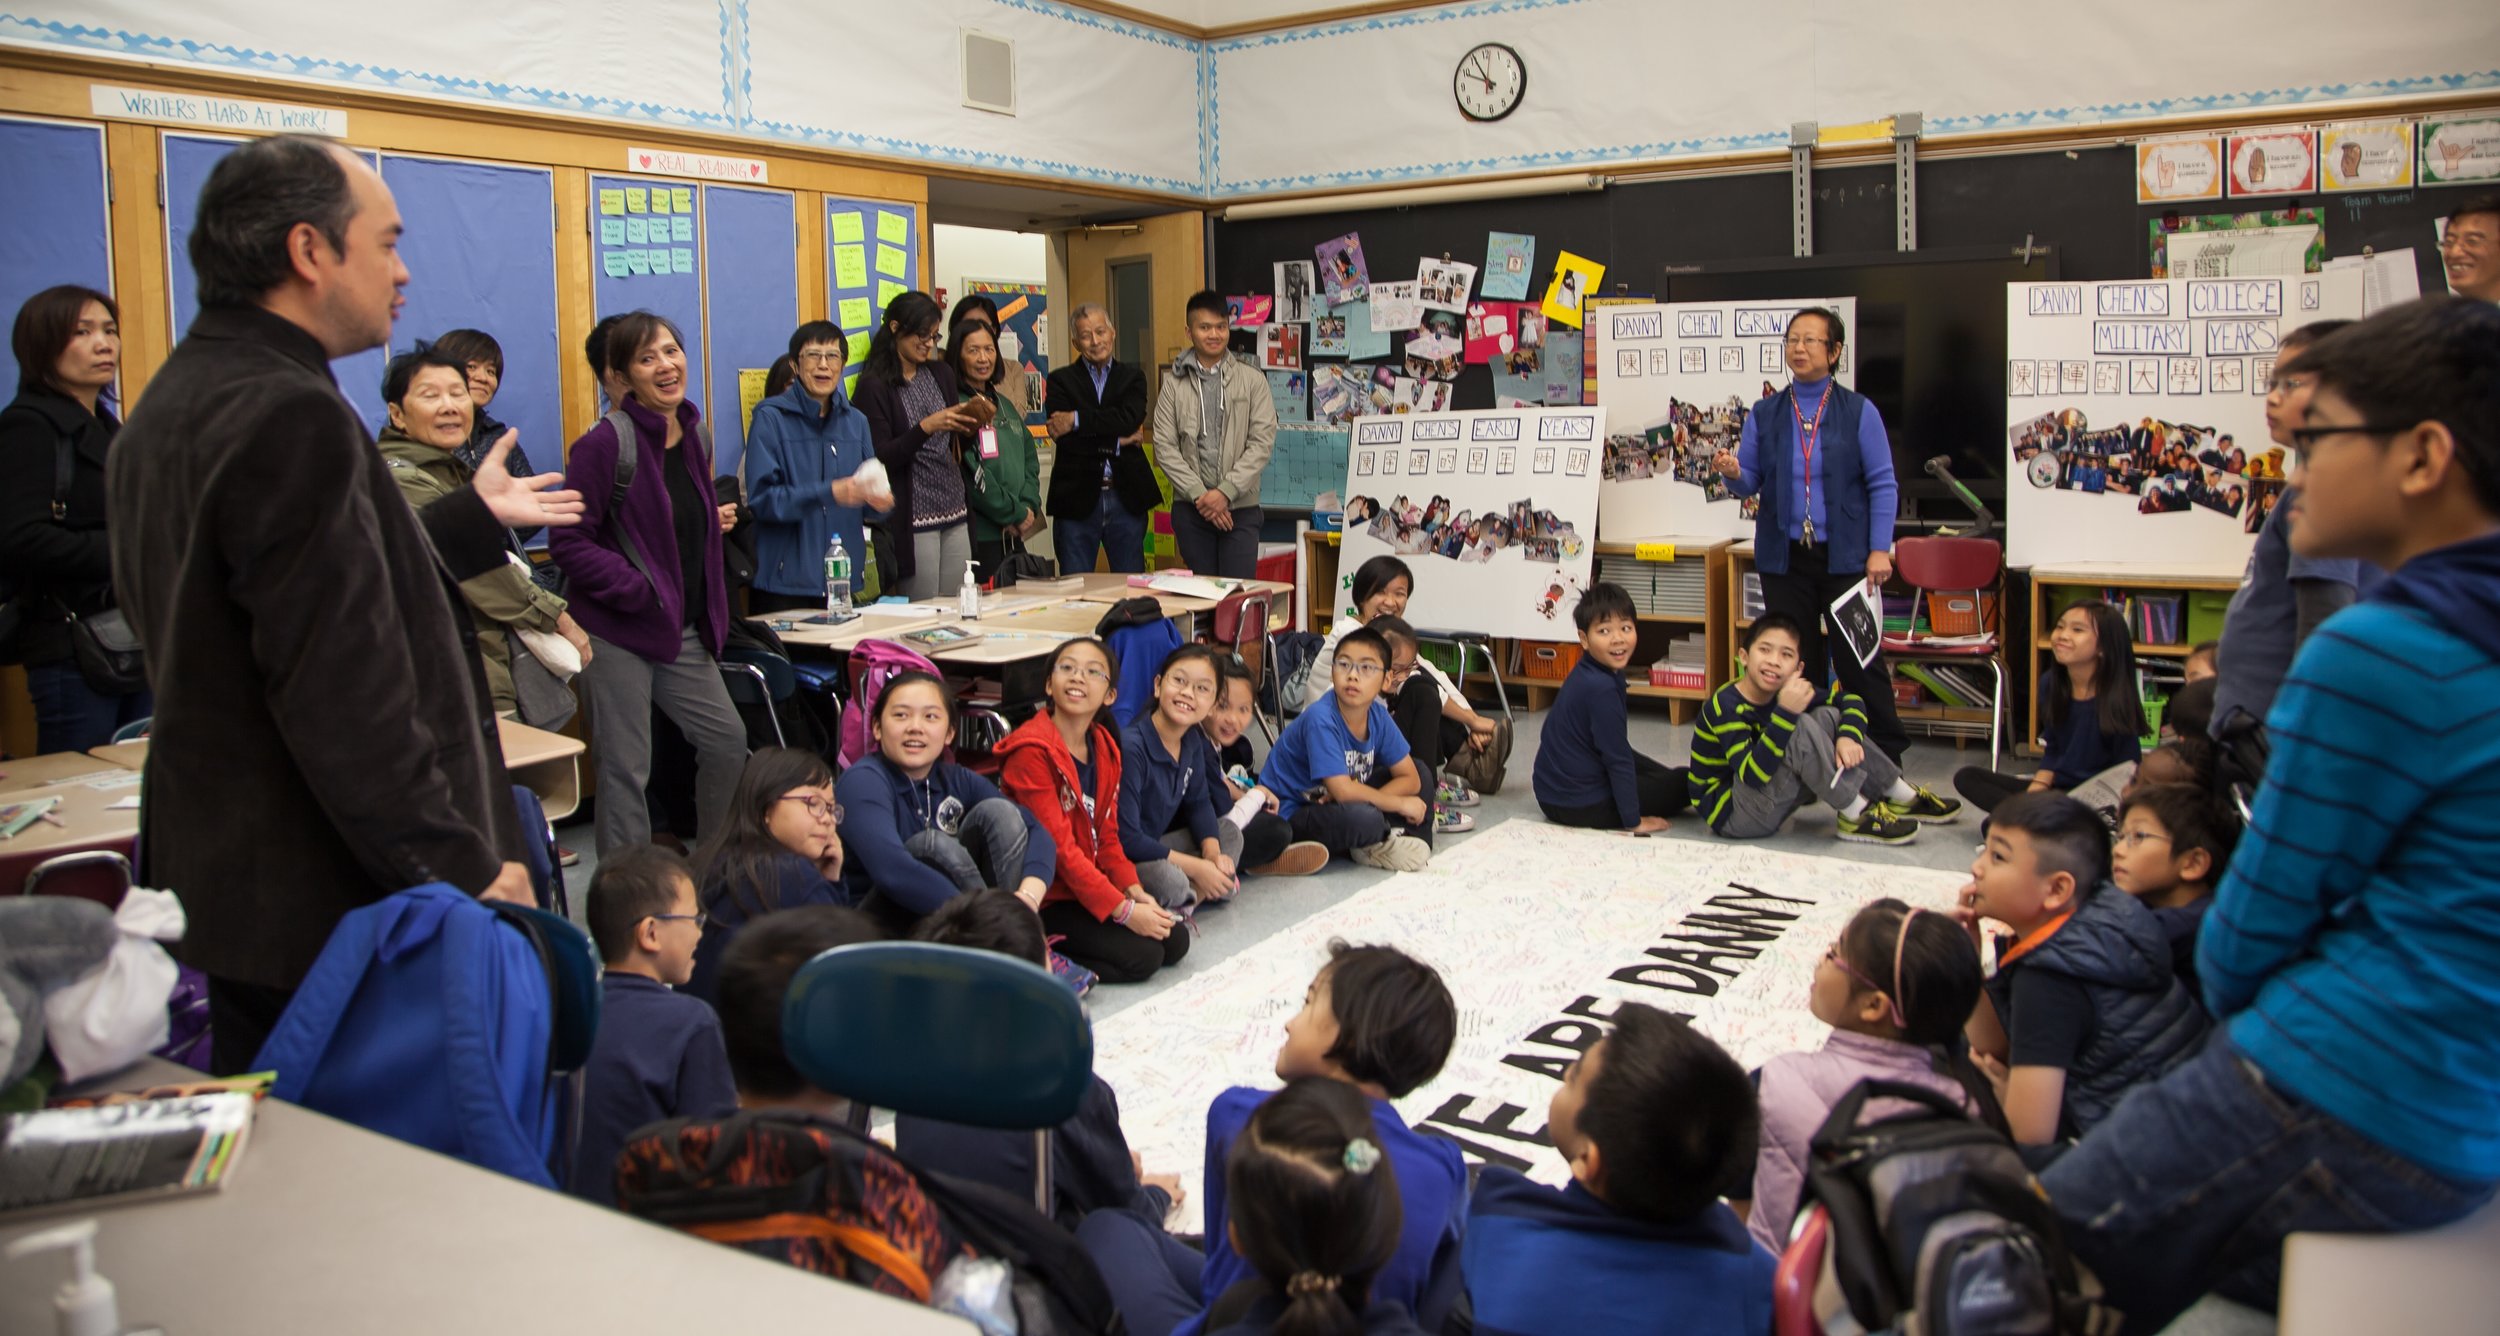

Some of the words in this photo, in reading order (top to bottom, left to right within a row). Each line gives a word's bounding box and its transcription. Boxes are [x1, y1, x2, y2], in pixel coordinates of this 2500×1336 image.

[1462, 68, 1470, 77] 10
[1460, 82, 1466, 92] 9
[1510, 86, 1514, 96] 4
[120, 91, 197, 120] WRITERS
[205, 99, 248, 125] HARD
[254, 105, 273, 127] AT
[280, 108, 329, 132] WORK!
[1476, 103, 1481, 112] 7
[655, 153, 694, 174] REAL
[698, 159, 748, 179] READING
[2341, 195, 2372, 208] Team
[2033, 286, 2079, 313] DANNY
[2100, 285, 2166, 313] CHEN'S
[2193, 283, 2278, 313] COLLEGE
[2303, 286, 2316, 307] &
[1616, 315, 1658, 338] DANNY
[1681, 314, 1718, 336] CHEN
[2098, 324, 2185, 351] MILITARY
[2209, 320, 2277, 352] YEARS
[1362, 424, 1401, 441] DANNY
[1474, 419, 1518, 438] EARLY
[1543, 418, 1591, 437] YEARS
[1608, 882, 1817, 998] DANNY
